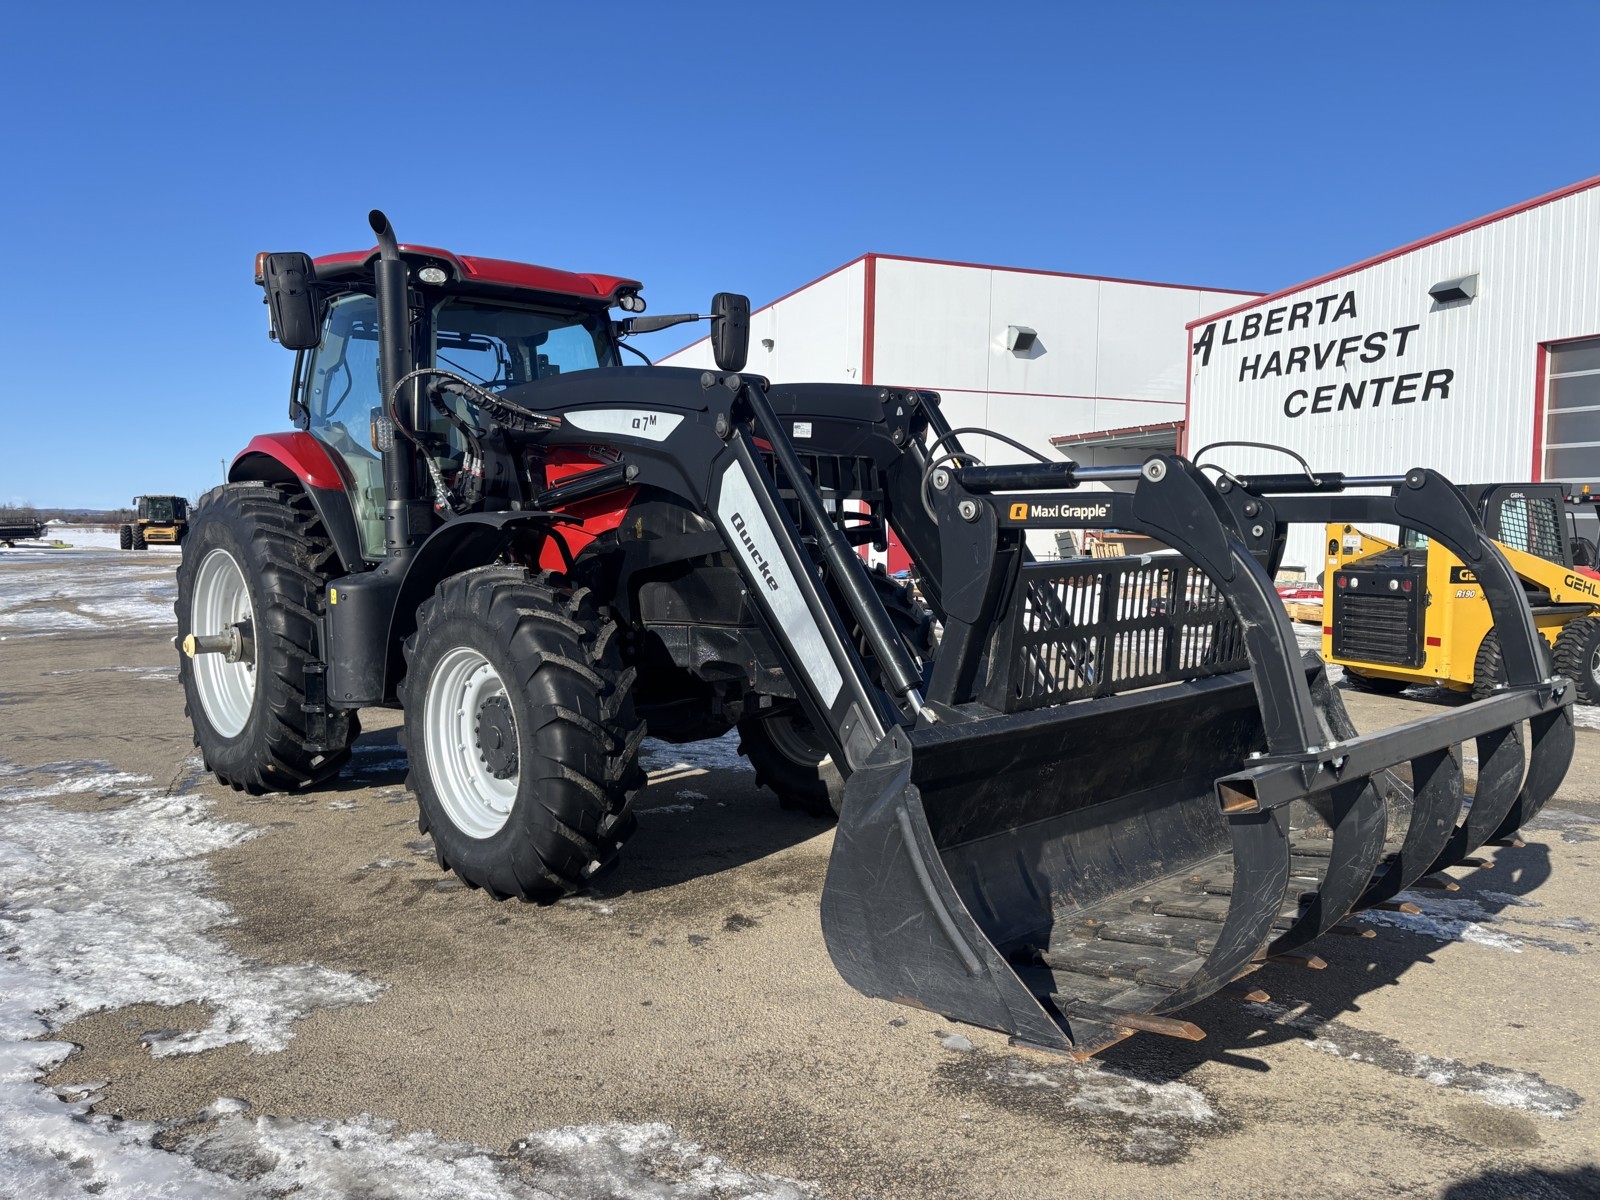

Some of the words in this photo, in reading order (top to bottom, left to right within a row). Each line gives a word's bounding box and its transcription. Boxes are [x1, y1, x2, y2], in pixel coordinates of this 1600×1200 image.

[1193, 290, 1357, 366] ALBERTA
[1284, 368, 1454, 418] CENTER
[1031, 505, 1059, 518] Maxi
[730, 512, 779, 592] Quicke
[1564, 574, 1599, 598] GEHL
